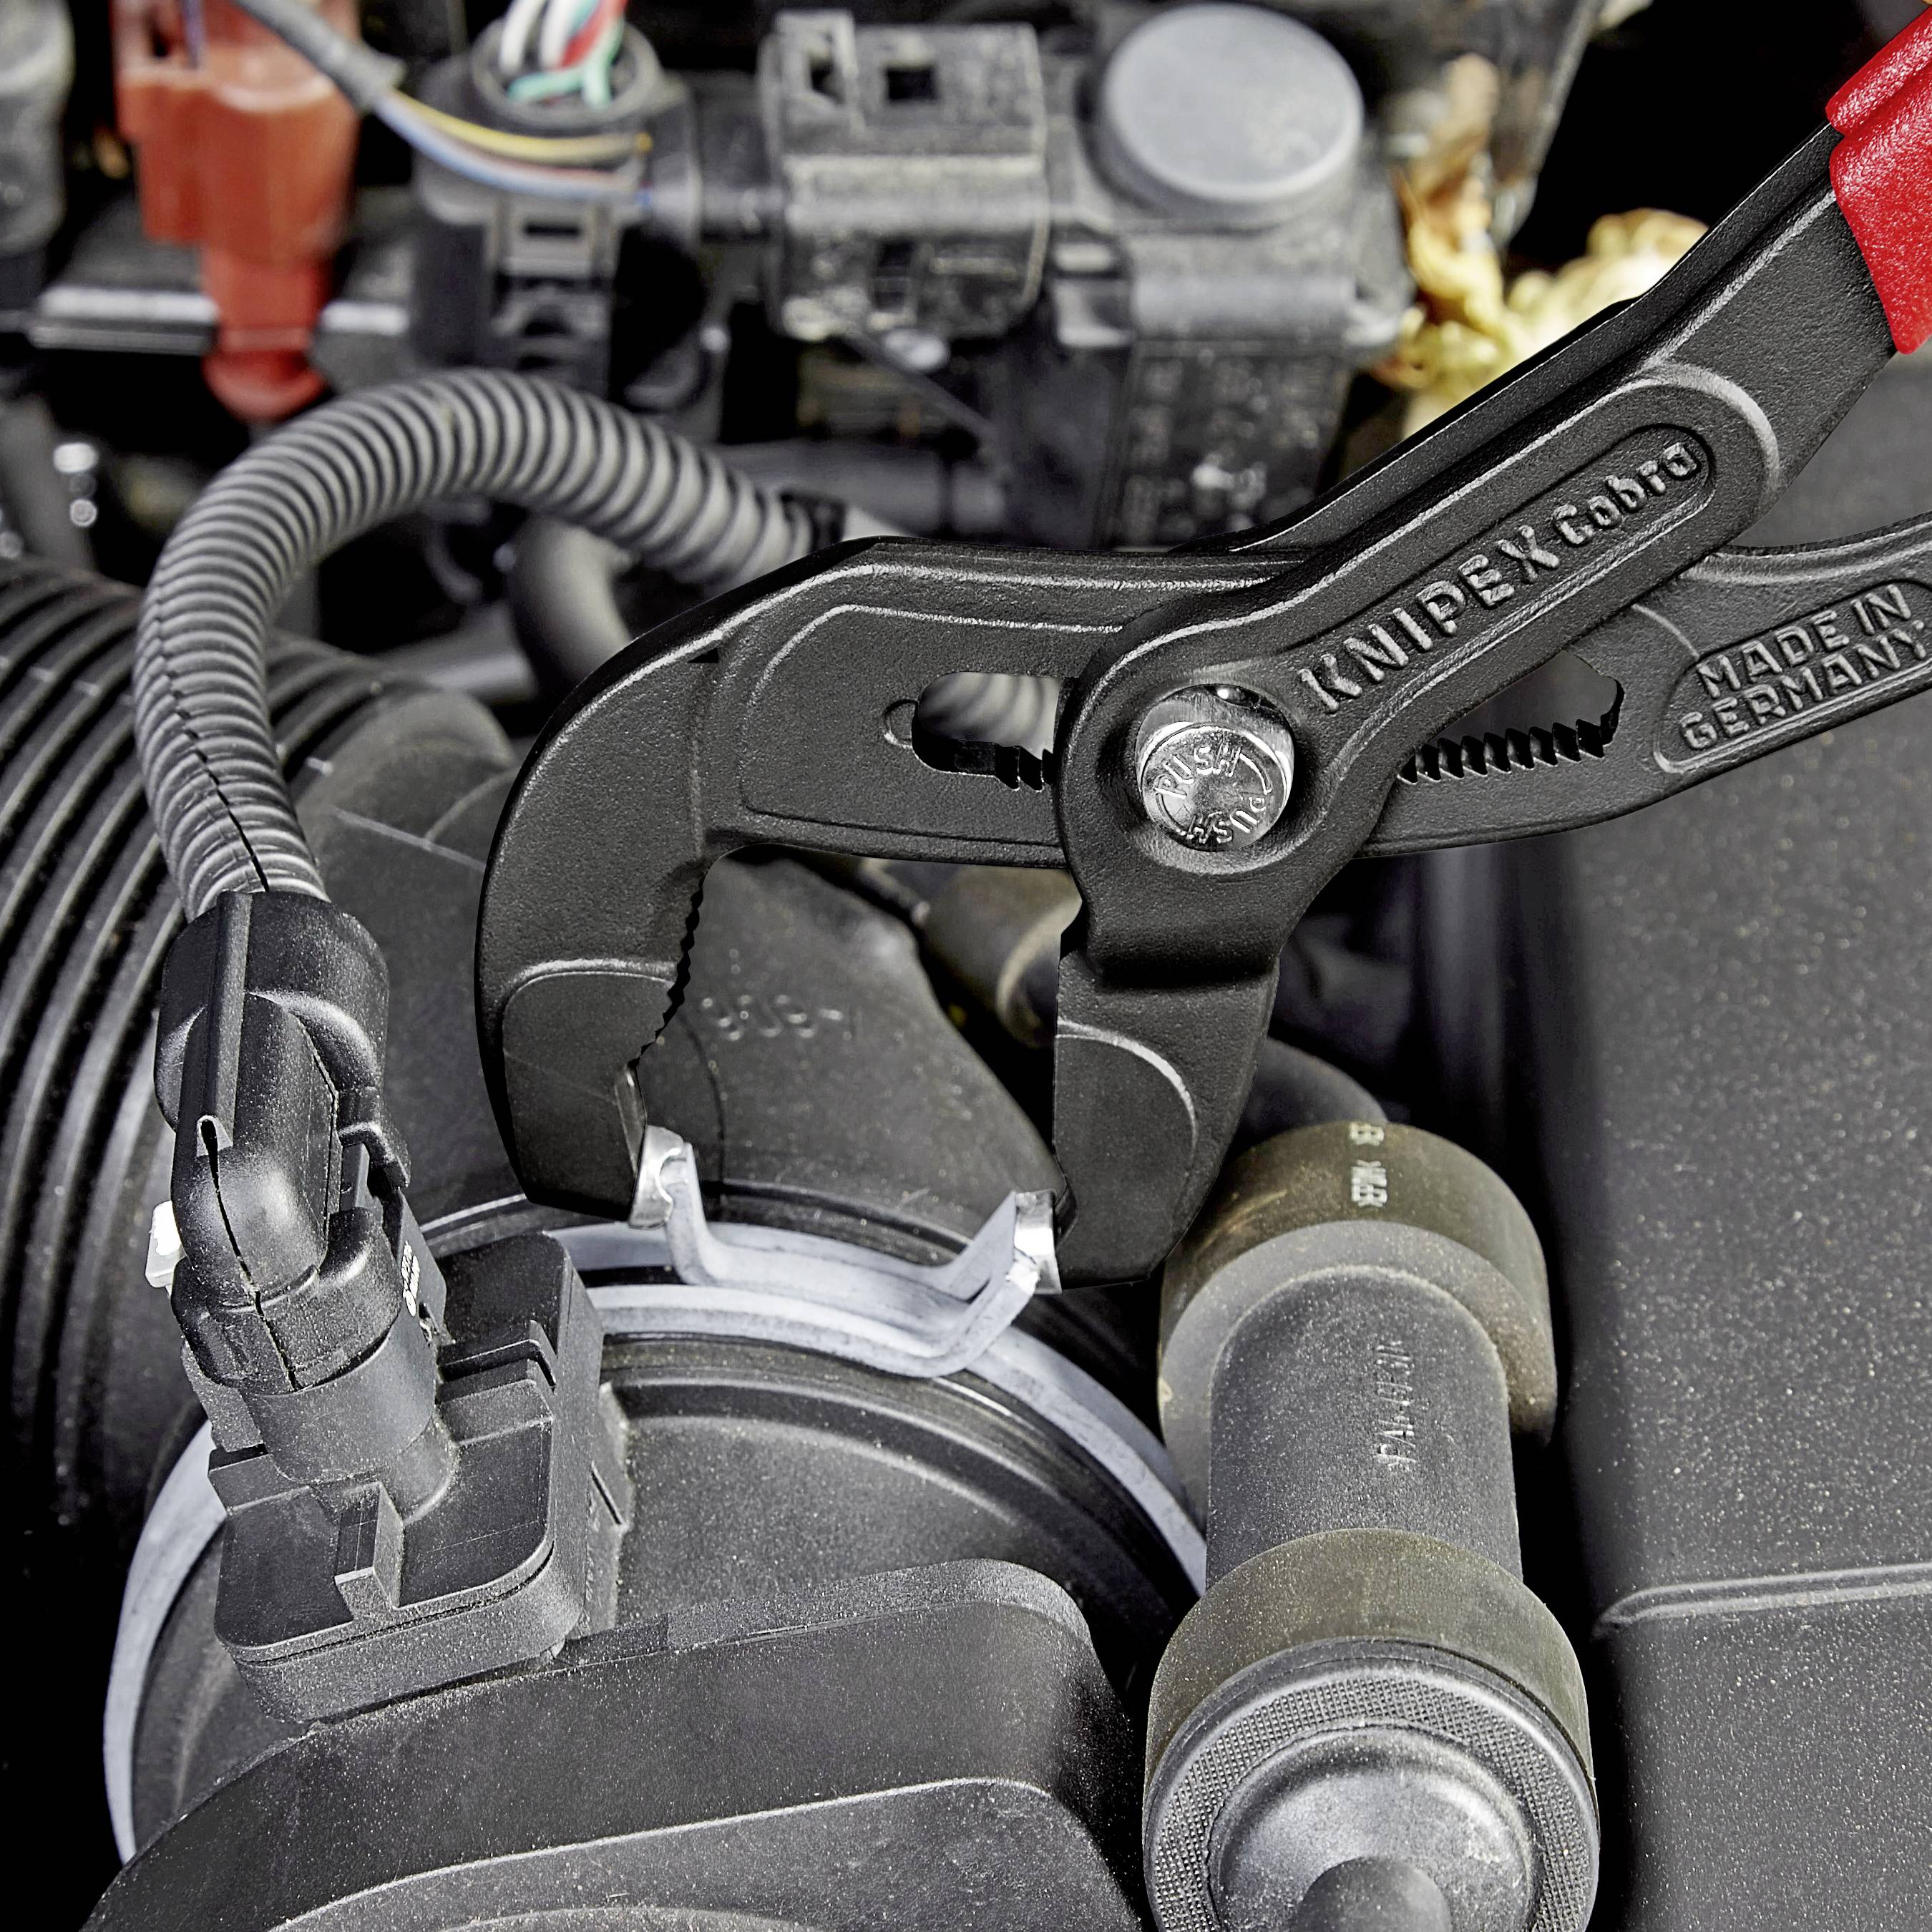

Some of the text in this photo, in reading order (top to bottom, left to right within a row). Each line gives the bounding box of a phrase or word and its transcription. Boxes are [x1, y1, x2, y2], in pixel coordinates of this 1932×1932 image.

[1297, 441, 1700, 713] KNIPEX Cobra
[1681, 620, 1926, 750] GERMANY
[1695, 584, 1912, 699] MADE IN
[1153, 742, 1243, 799] PUSH
